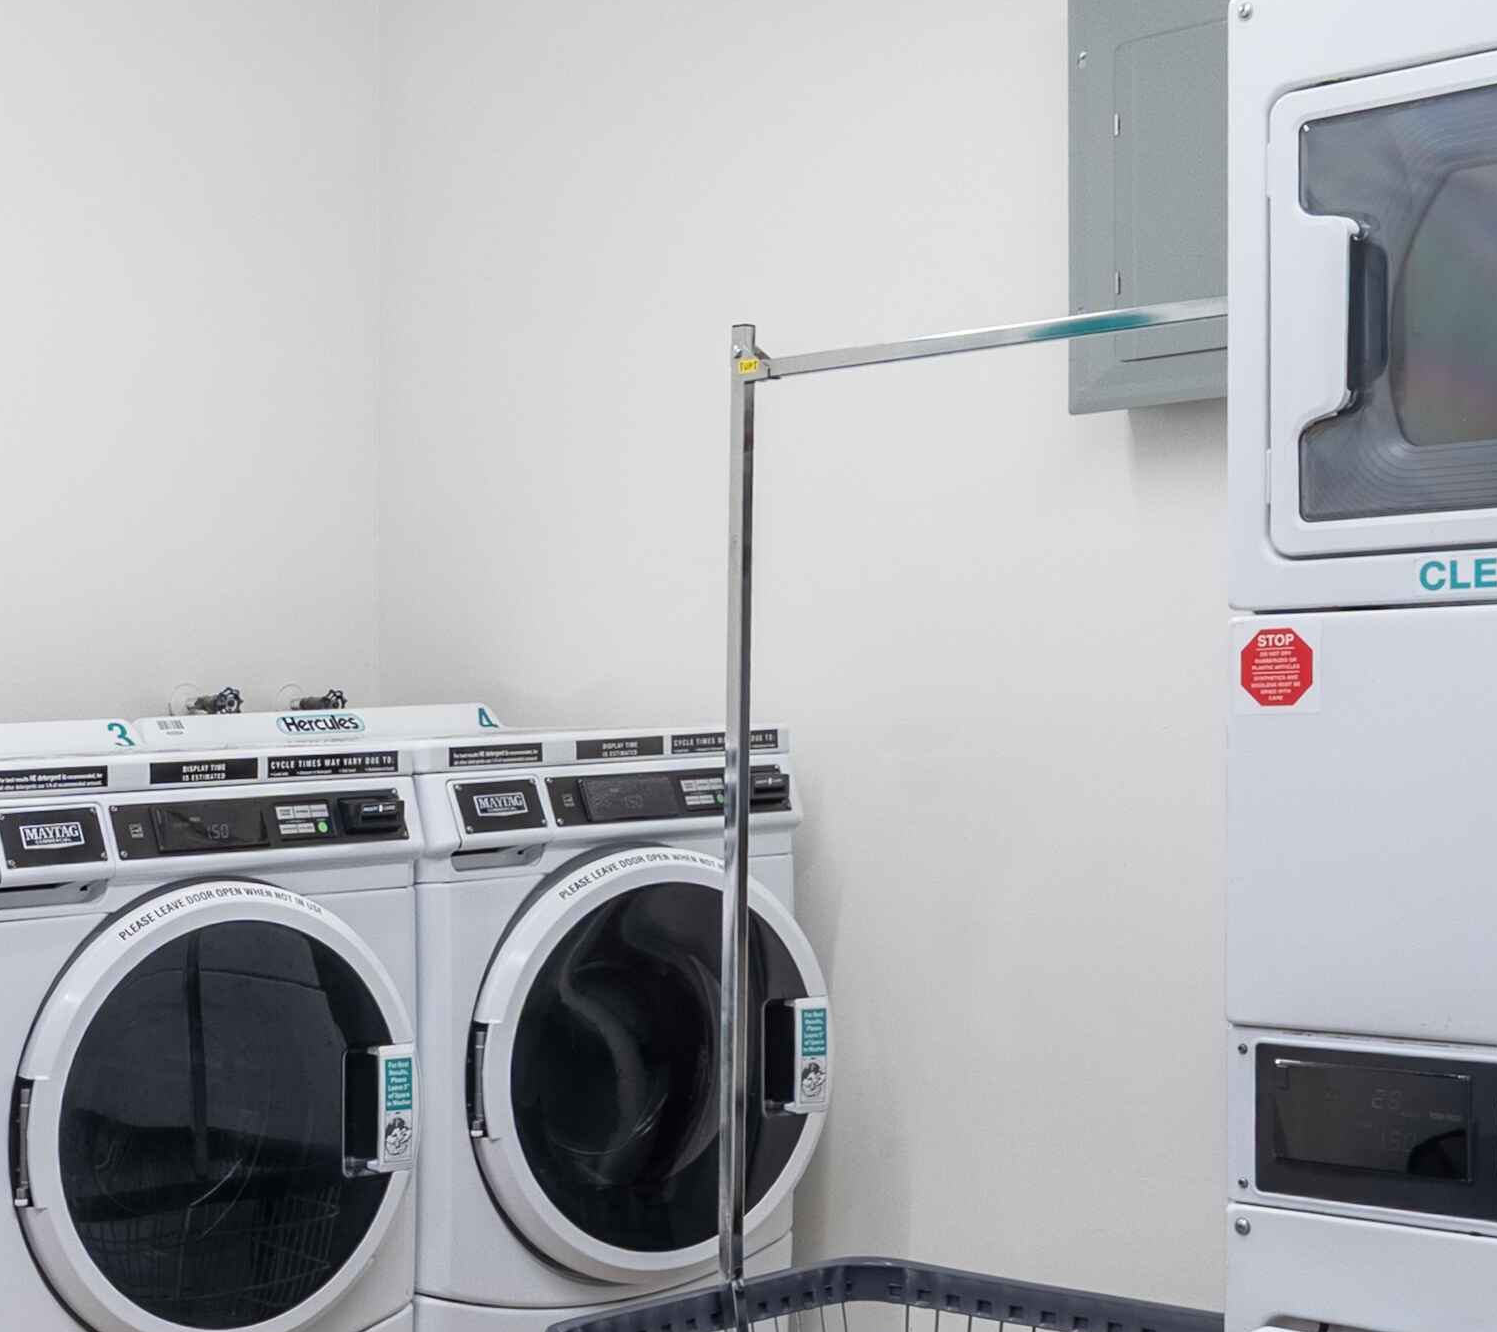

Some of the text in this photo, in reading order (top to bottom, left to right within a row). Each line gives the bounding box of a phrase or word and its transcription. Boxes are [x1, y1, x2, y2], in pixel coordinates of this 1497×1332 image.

[1257, 633, 1294, 647] STOP
[283, 715, 359, 733] Hercules
[108, 722, 135, 747] 3
[24, 823, 79, 840] MAYTAG
